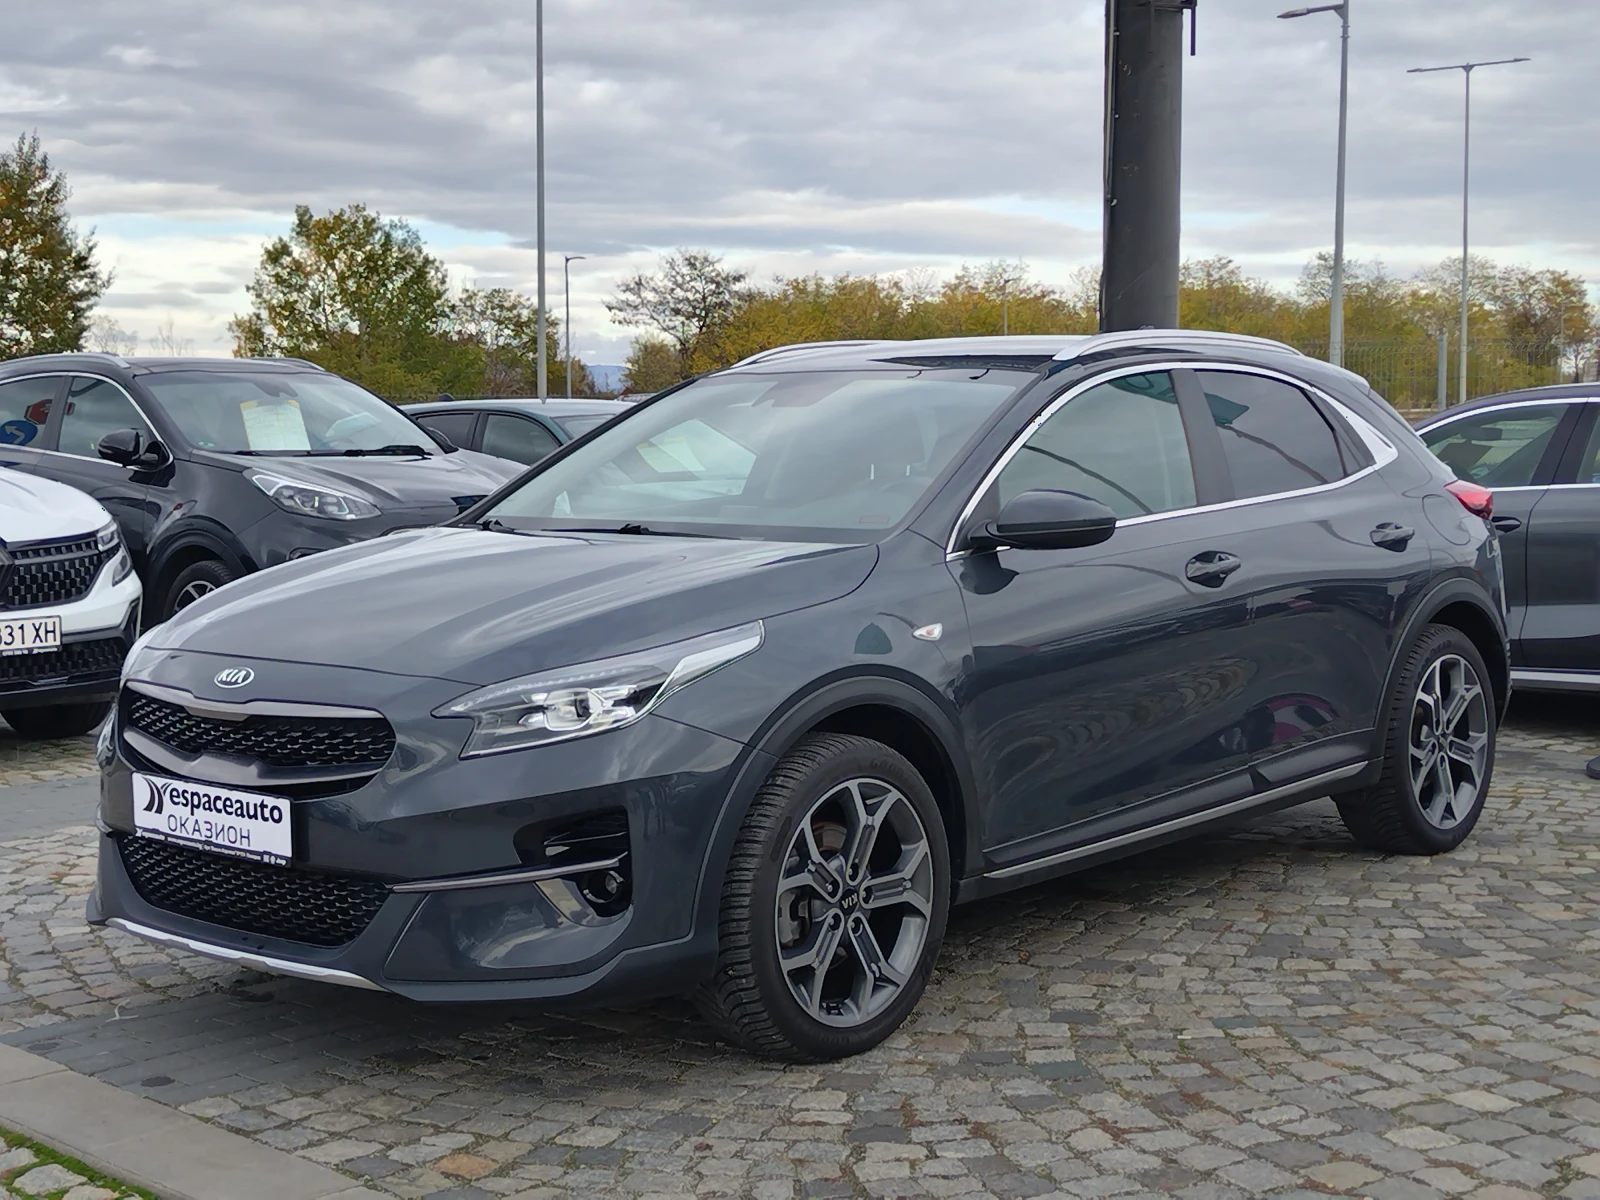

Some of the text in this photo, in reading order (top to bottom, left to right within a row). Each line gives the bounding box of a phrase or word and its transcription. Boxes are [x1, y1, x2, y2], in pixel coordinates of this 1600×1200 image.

[0, 621, 57, 646] 31 XH
[217, 668, 248, 684] KIA
[169, 787, 283, 824] espaceauto
[167, 814, 251, 848] ОКАЗИОН
[841, 892, 858, 909] KIA
